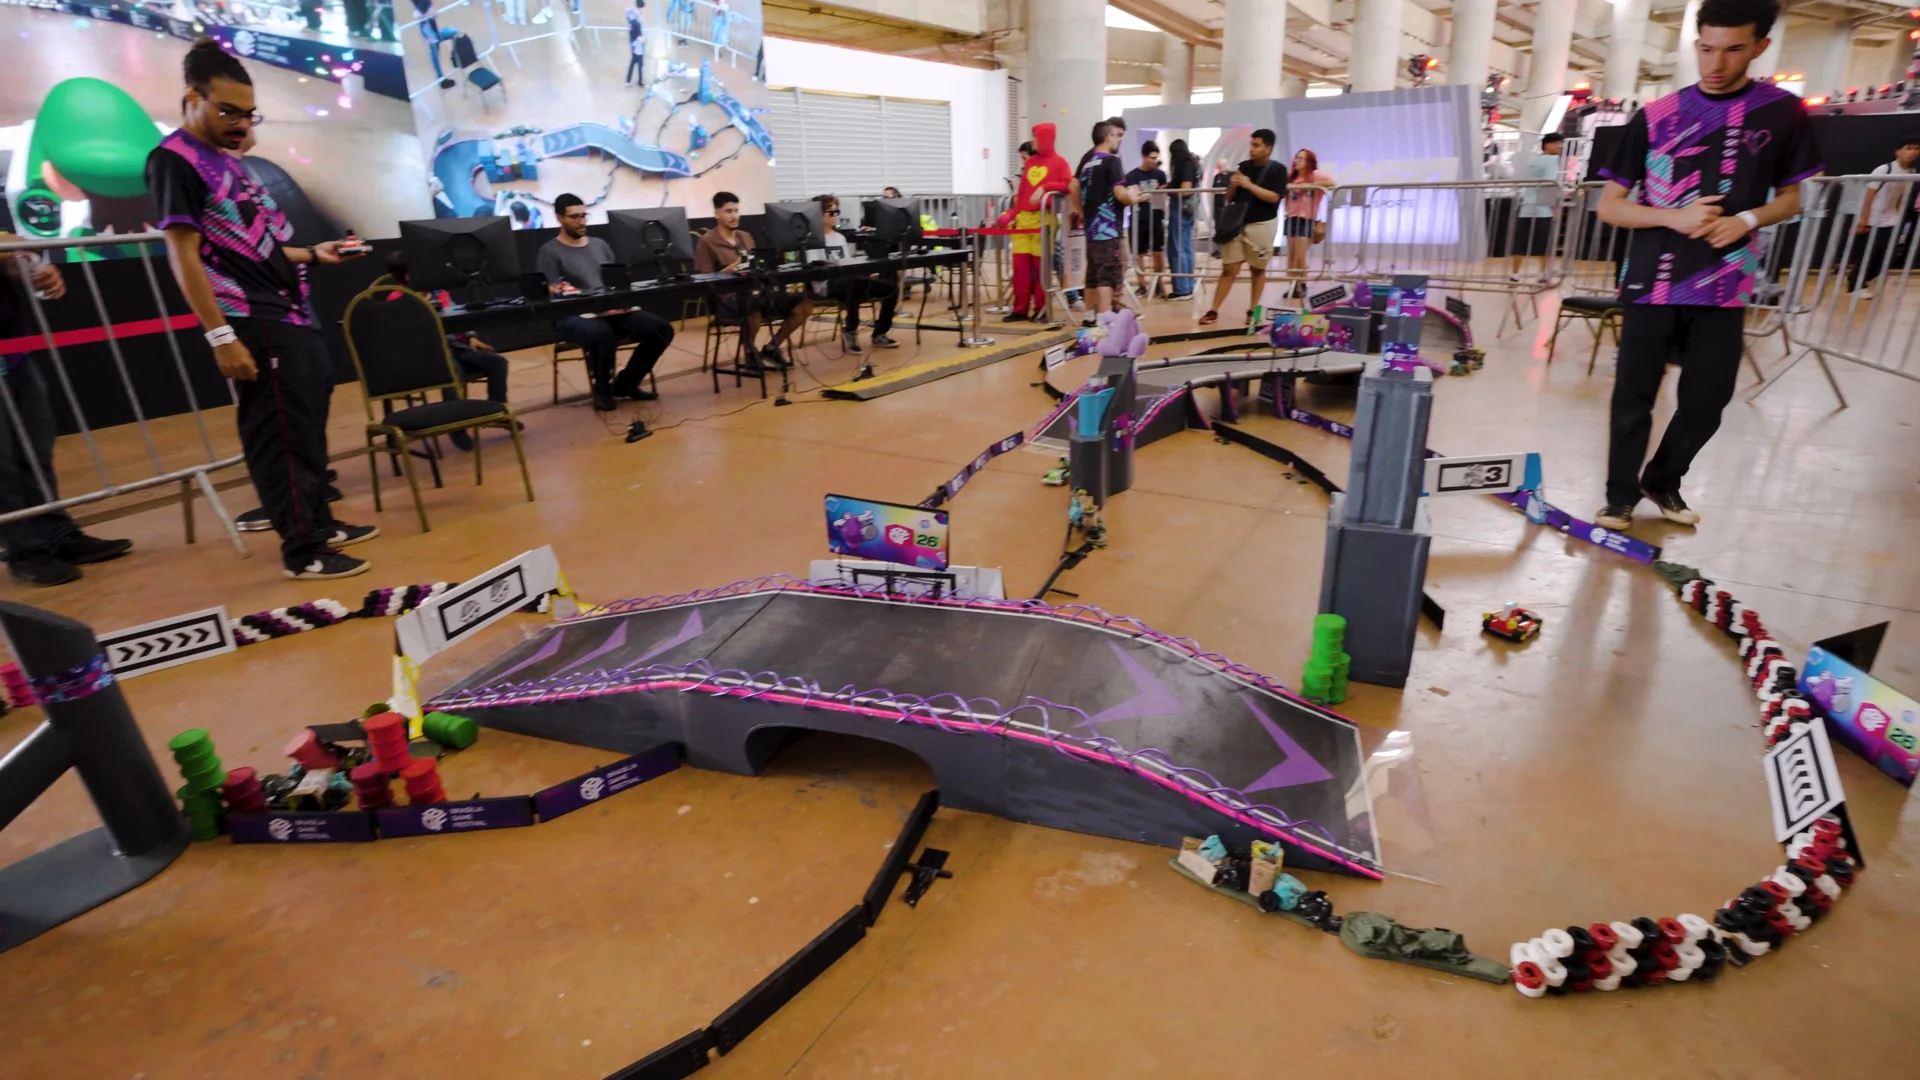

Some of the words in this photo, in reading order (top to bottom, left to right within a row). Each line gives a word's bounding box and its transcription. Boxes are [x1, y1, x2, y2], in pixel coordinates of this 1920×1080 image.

[1372, 199, 1414, 208] SPORTS
[1485, 466, 1503, 482] 3
[916, 534, 938, 547] 26
